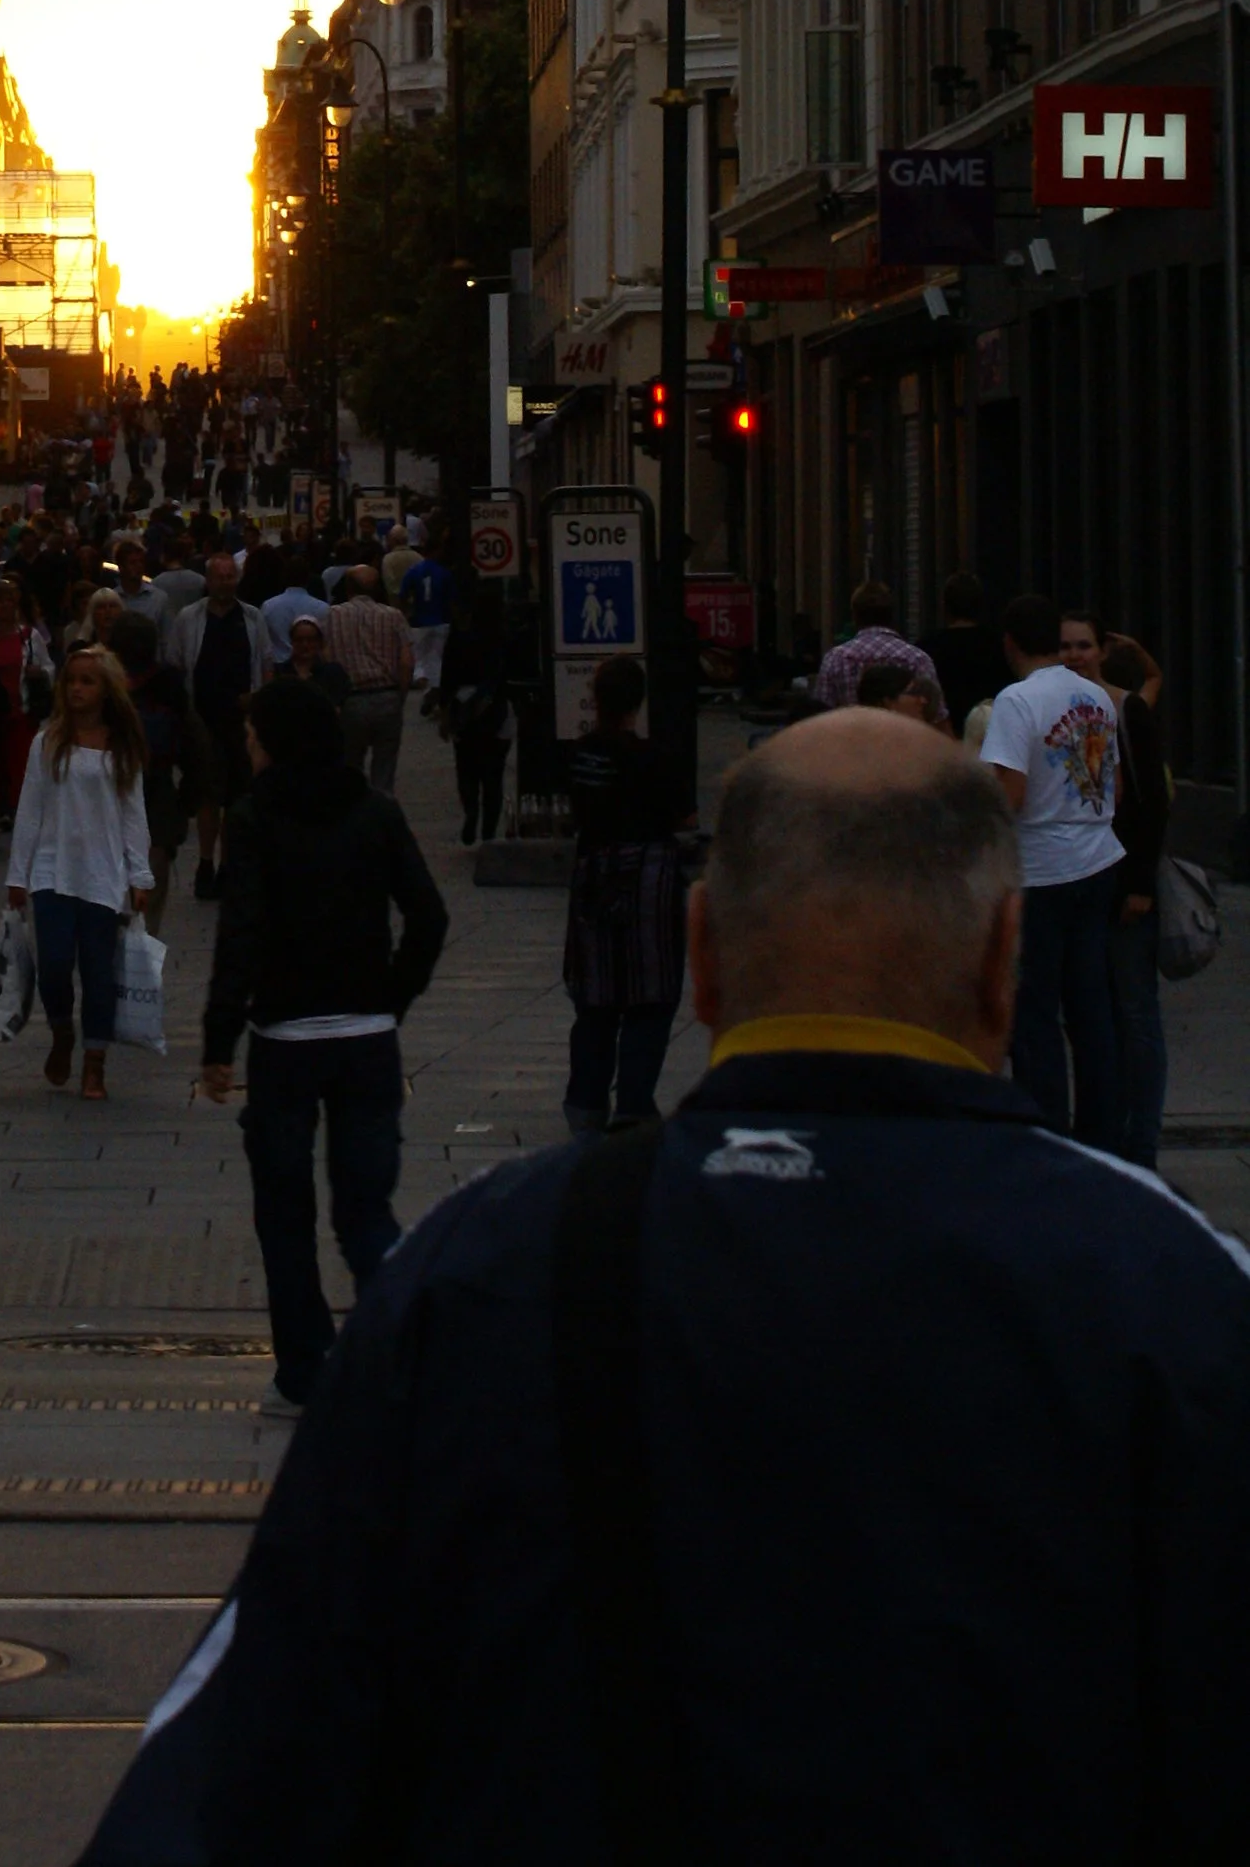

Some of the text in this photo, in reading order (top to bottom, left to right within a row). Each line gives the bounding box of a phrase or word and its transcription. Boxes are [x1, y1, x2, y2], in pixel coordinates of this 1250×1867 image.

[888, 157, 987, 187] GAME
[471, 505, 510, 521] Sone
[566, 521, 627, 545] Sone
[477, 538, 506, 560] 30
